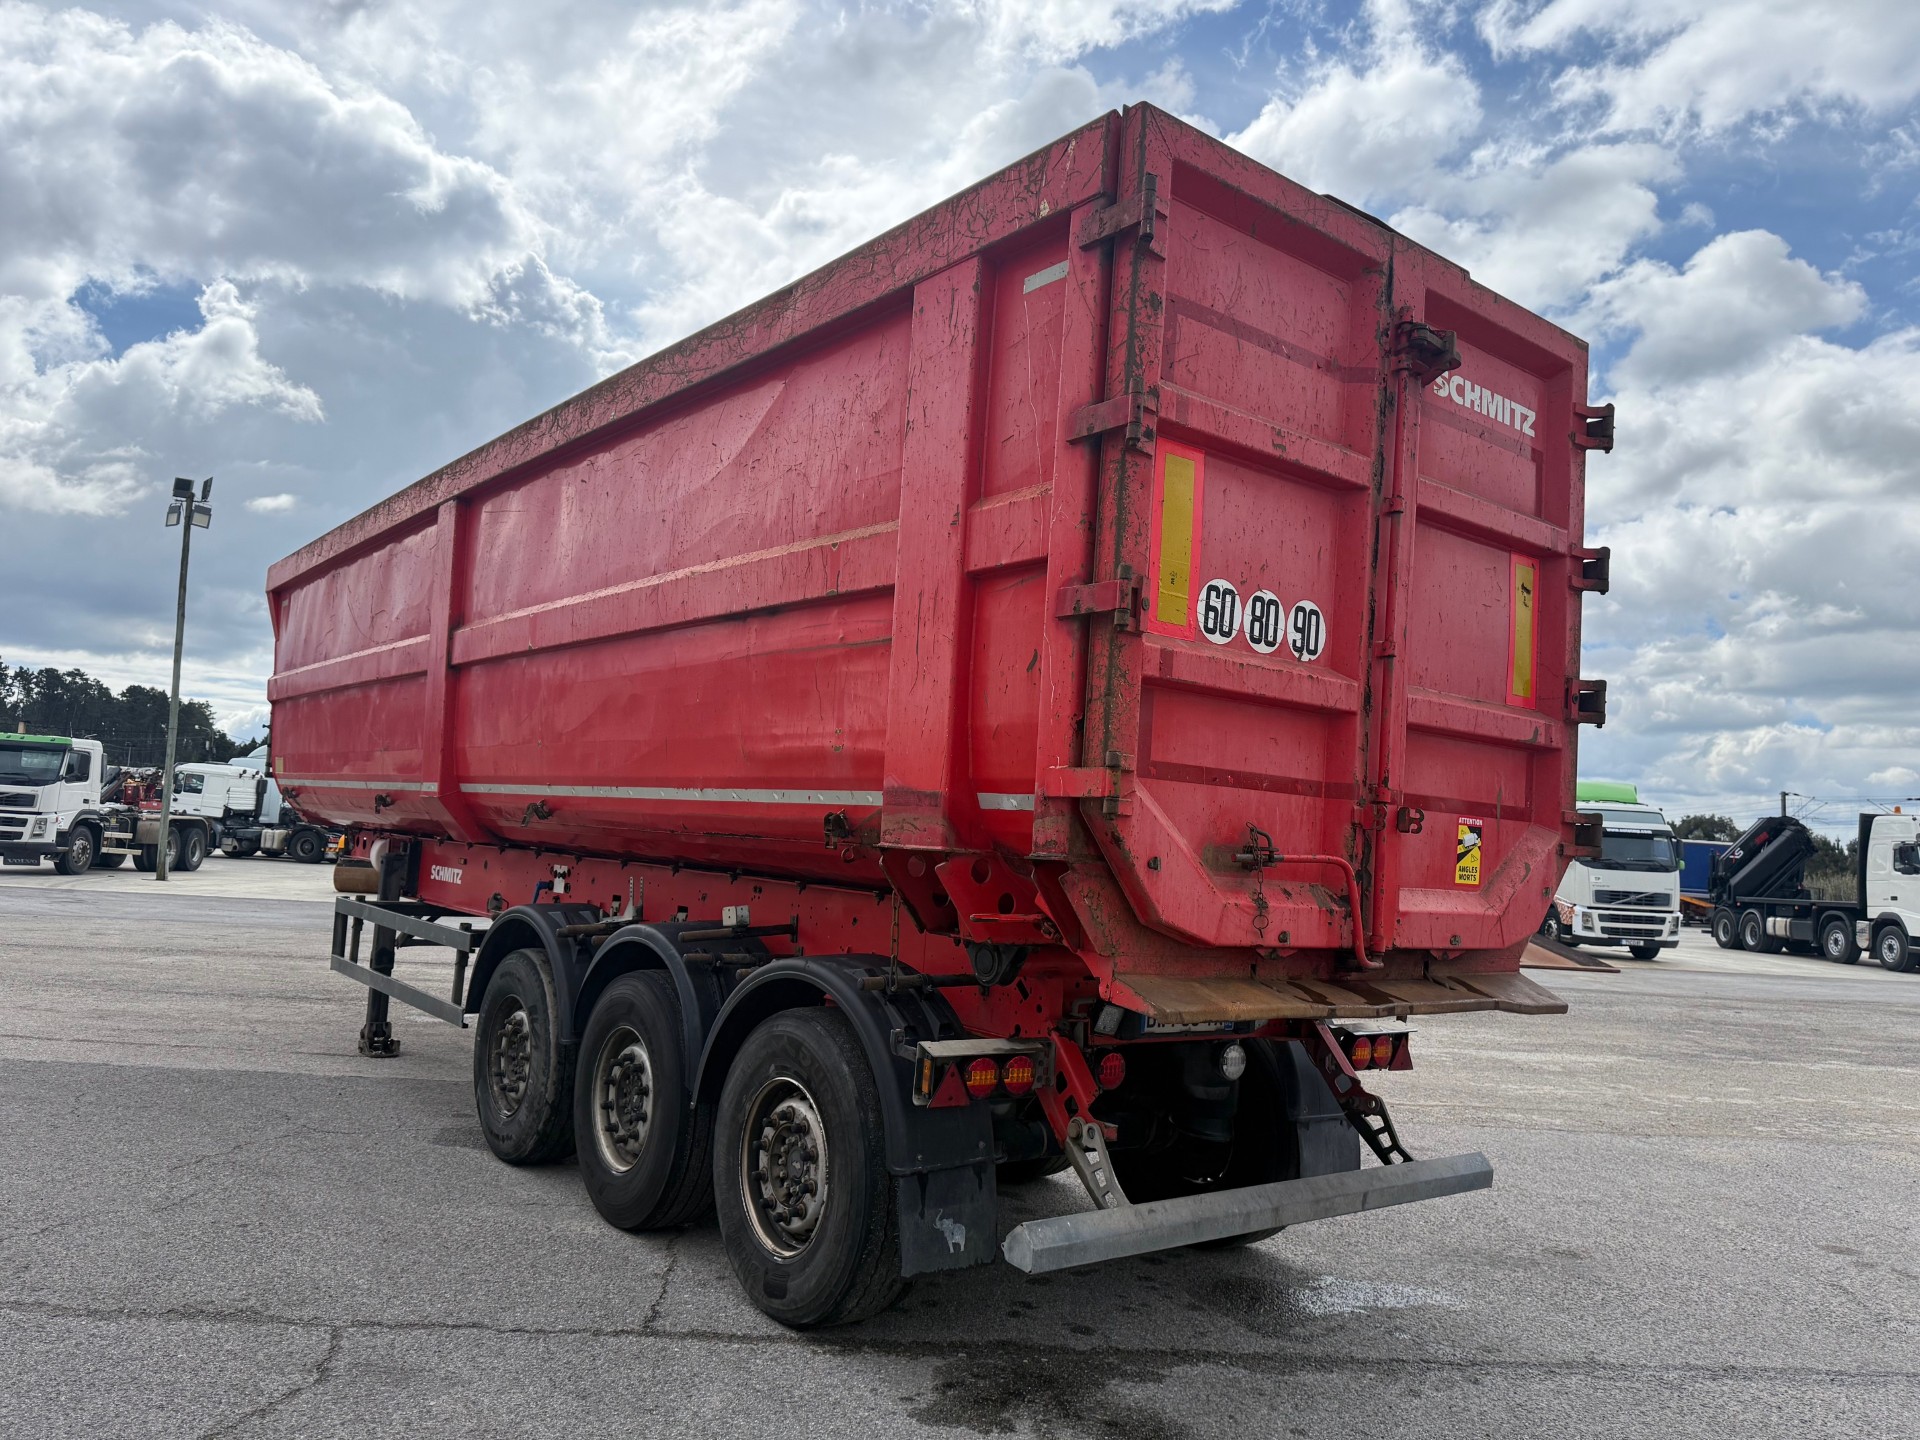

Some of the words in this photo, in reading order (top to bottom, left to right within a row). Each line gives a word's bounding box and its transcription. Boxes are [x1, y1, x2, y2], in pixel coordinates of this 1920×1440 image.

[1433, 371, 1536, 438] SCHMITZ
[1203, 584, 1236, 638] 60
[1249, 595, 1280, 647] 80
[1292, 605, 1320, 656] 90
[1458, 817, 1483, 826] ATTENTION
[430, 865, 463, 884] SCHMITZ
[1458, 865, 1478, 874] ANGLES
[1458, 873, 1477, 882] MORTS
